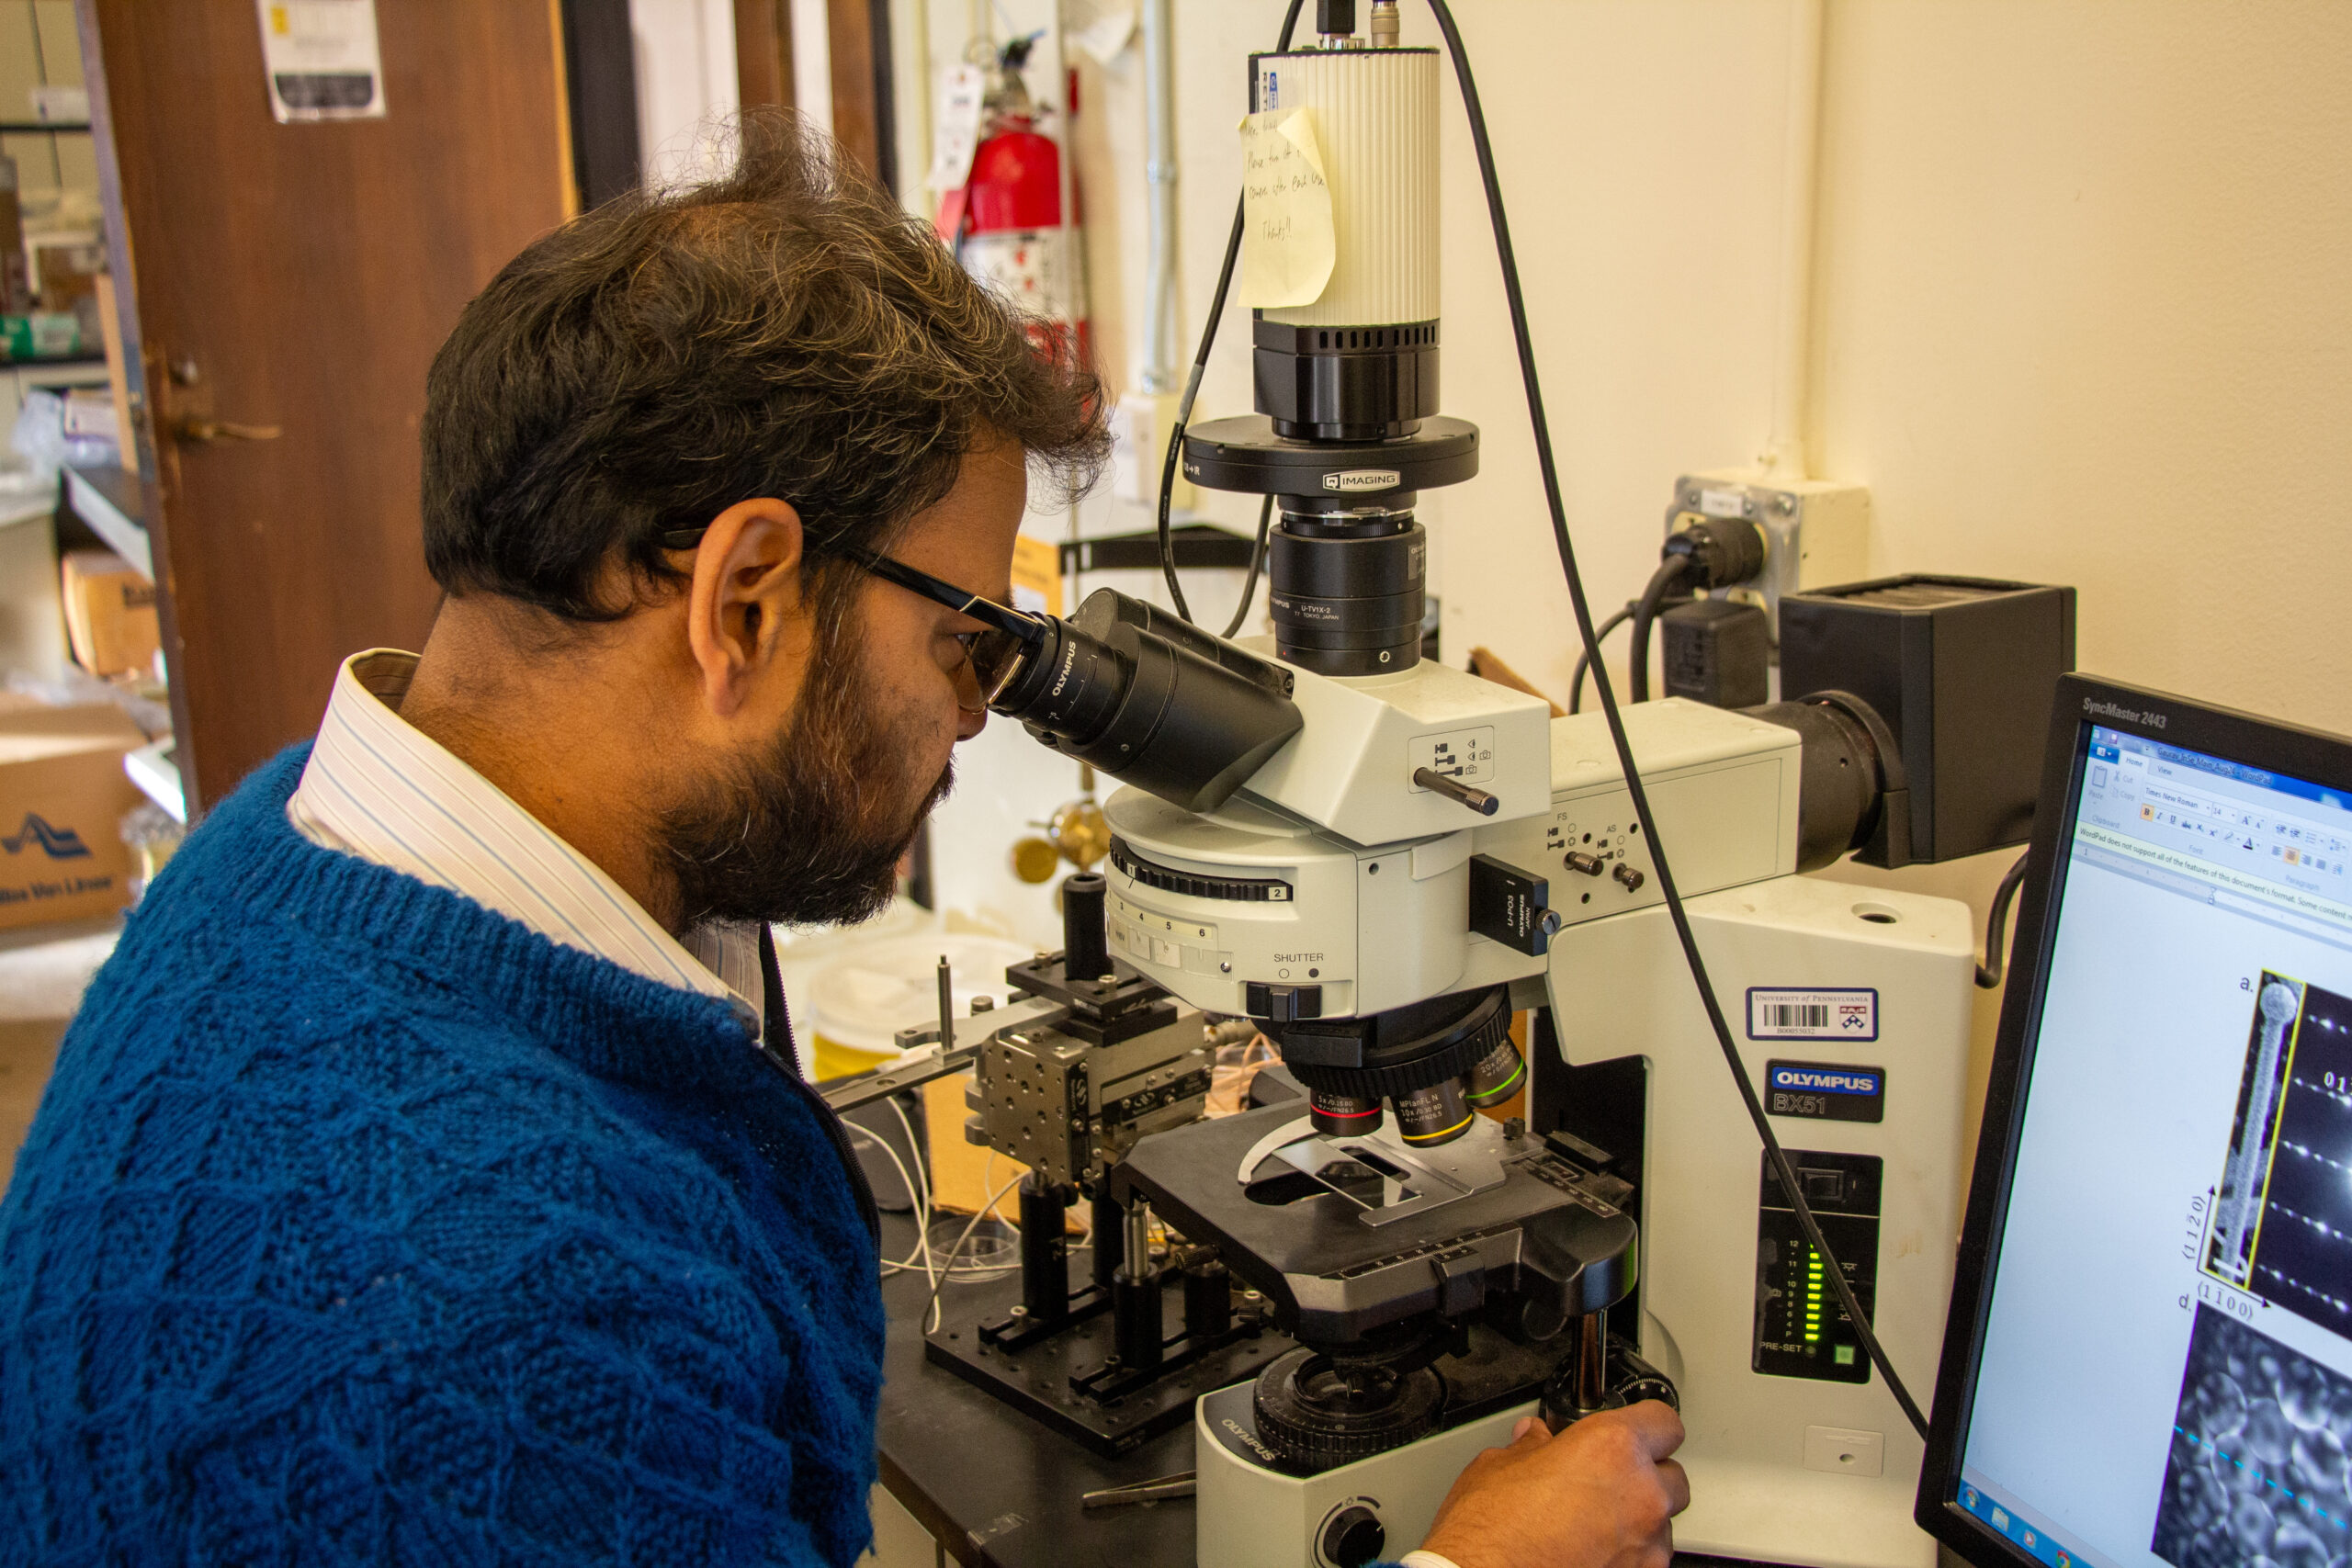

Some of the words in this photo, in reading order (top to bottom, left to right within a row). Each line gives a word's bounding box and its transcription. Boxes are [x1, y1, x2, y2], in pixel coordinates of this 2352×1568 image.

[1342, 474, 1396, 486] IMAGING
[1051, 640, 1077, 697] OLYMPUS
[2083, 697, 2142, 723] SyncMaster
[2141, 711, 2167, 728] 2443
[2125, 756, 2143, 768] Home
[2157, 765, 2173, 776] View
[2145, 786, 2163, 798] Times
[2163, 792, 2177, 803] New
[2177, 796, 2199, 809] Roman
[1557, 812, 1567, 821] FS
[1606, 825, 1617, 833] AS
[2079, 827, 2107, 842] WordPad
[2107, 836, 2121, 848] does
[2121, 841, 2132, 851] not
[2133, 846, 2156, 859] support
[2165, 855, 2173, 863] of
[2173, 858, 2184, 867] the
[2185, 862, 2210, 876] features
[2219, 873, 2231, 882] this
[2297, 897, 2321, 911] Some
[2319, 904, 2347, 919] content
[1274, 888, 1281, 897] 2
[1166, 921, 1171, 931] 5
[1199, 929, 1205, 937] 6
[1273, 953, 1324, 963] SHUTTER
[1800, 994, 1810, 1002] of
[1777, 1070, 1874, 1091] OLYMPUS
[1773, 1093, 1826, 1114] BX51
[1759, 1341, 1803, 1353] PRE-SET
[1221, 1418, 1276, 1461] OLYMPUS
